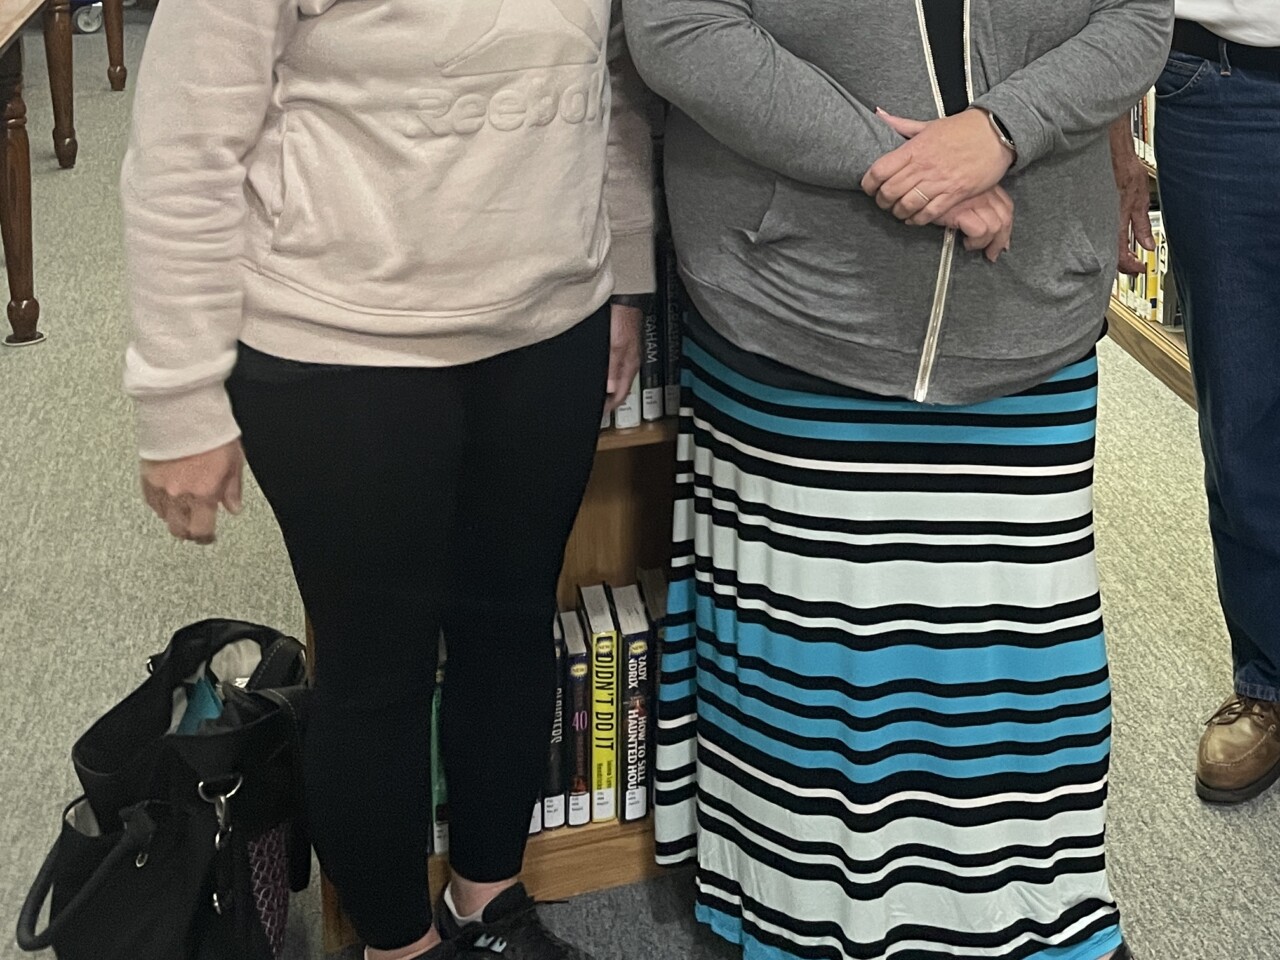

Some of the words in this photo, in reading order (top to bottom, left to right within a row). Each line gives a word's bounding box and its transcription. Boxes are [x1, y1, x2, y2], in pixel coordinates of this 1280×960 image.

[595, 654, 614, 706] DIDN'T
[572, 711, 587, 731] 40
[596, 711, 614, 732] DO
[639, 716, 647, 741] HOW
[595, 737, 614, 751] IT
[628, 710, 639, 762] HAUNTED
[639, 743, 647, 758] TO
[627, 764, 638, 790] HOU
[638, 760, 647, 782] SELL
